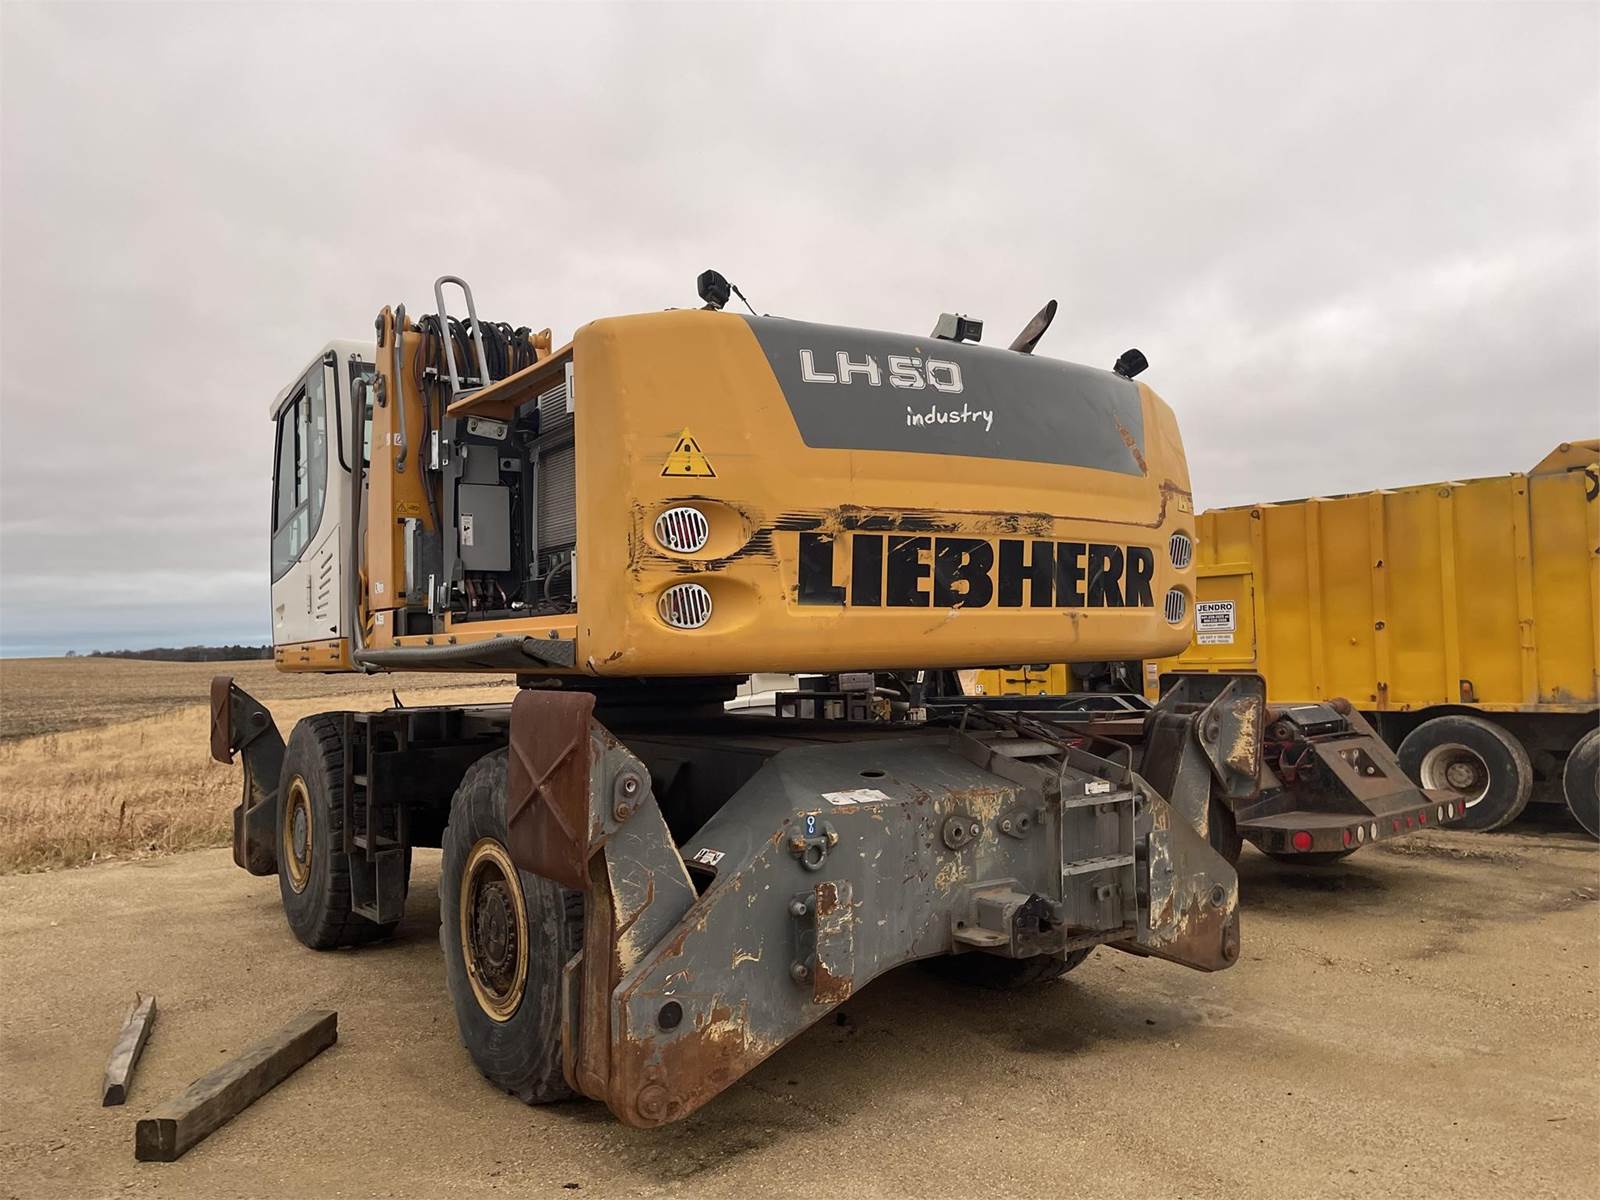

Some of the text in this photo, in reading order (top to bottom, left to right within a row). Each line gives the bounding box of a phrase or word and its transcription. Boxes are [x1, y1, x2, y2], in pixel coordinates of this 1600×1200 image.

[906, 403, 994, 432] industry
[798, 531, 1155, 609] LIEBHERR
[1198, 603, 1232, 611] JENDRO
